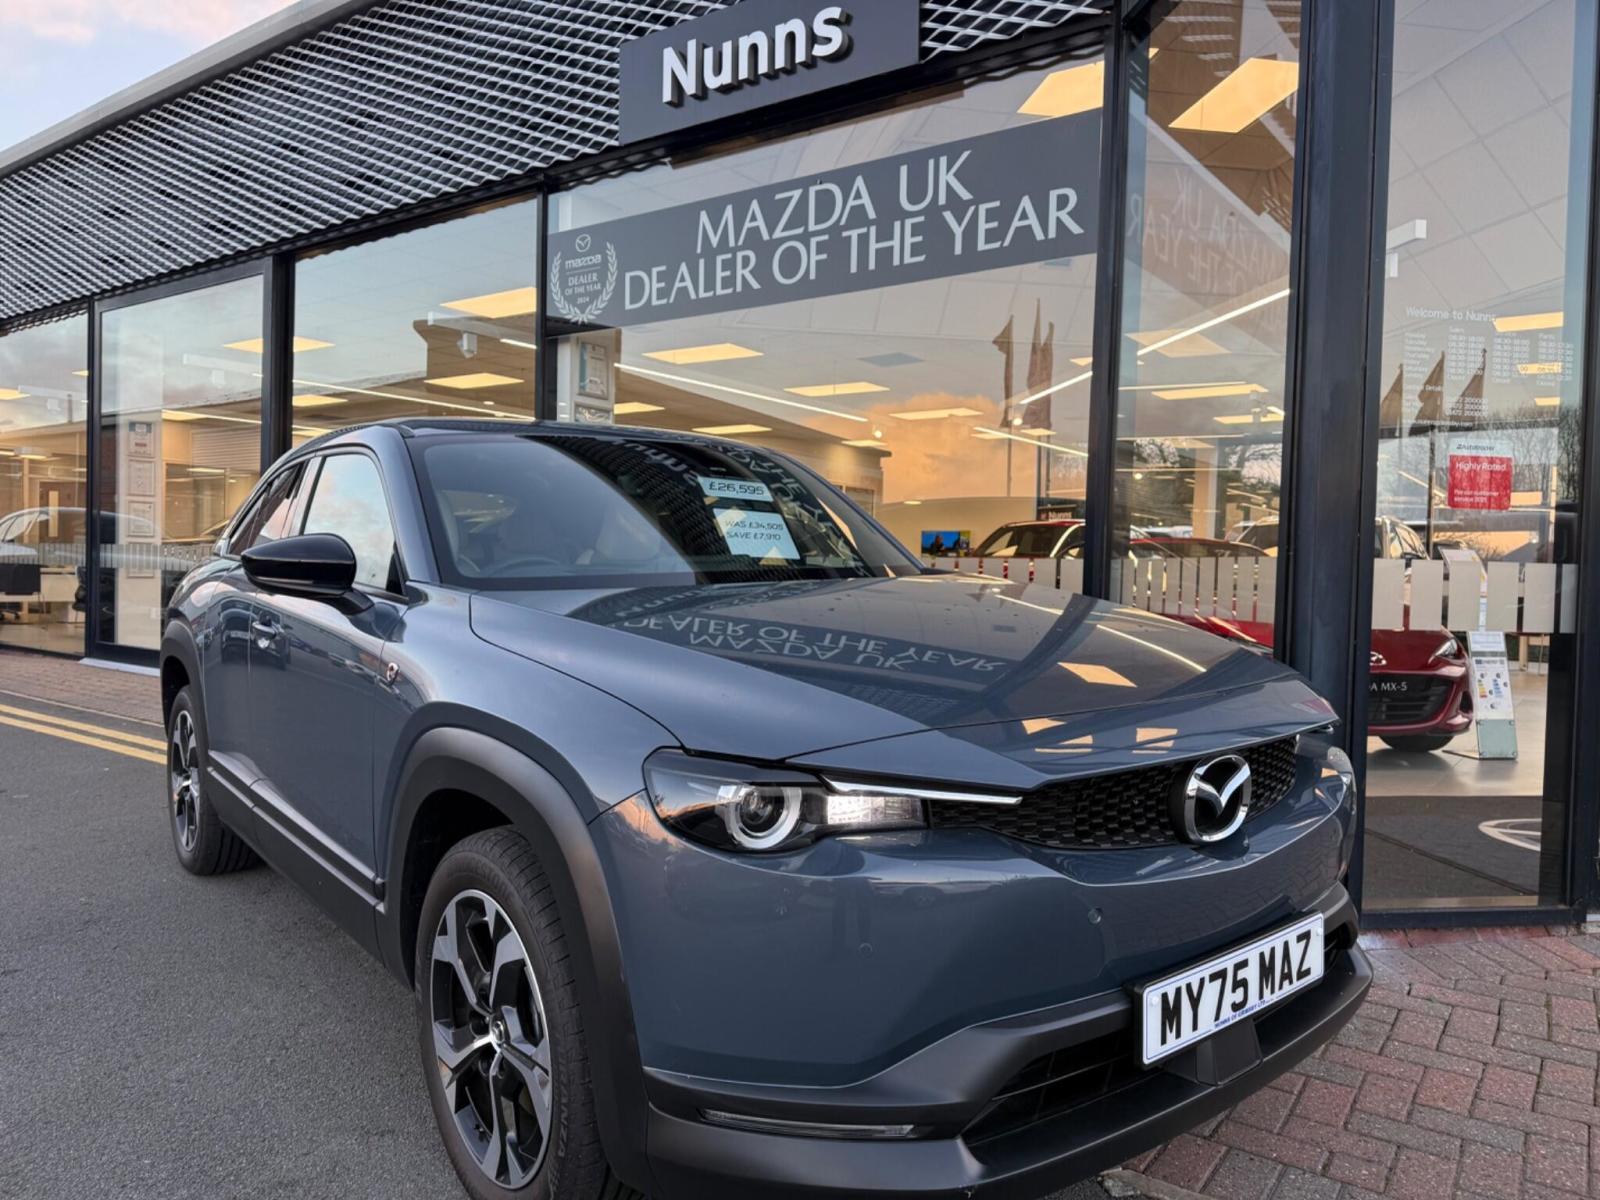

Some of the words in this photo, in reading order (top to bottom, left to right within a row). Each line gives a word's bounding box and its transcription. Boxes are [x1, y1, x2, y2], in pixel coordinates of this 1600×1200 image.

[661, 5, 848, 105] Nunns
[696, 174, 877, 255] MAZDA
[898, 150, 974, 212] UK
[624, 251, 762, 312] DEALER
[772, 236, 829, 286] OF
[841, 215, 927, 273] THE
[941, 186, 1085, 256] YEAR
[568, 273, 599, 286] DEALER
[564, 286, 574, 296] OF
[574, 284, 585, 294] THE
[586, 282, 602, 291] YEAR
[1407, 306, 1449, 319] Welcome
[1453, 310, 1462, 320] to
[708, 481, 765, 495] £26,595
[725, 519, 747, 529] WAS
[726, 531, 752, 540] SAVE
[1381, 681, 1408, 692] MX-5
[1160, 957, 1250, 1047] MY75
[1258, 929, 1312, 1001] MAZ
